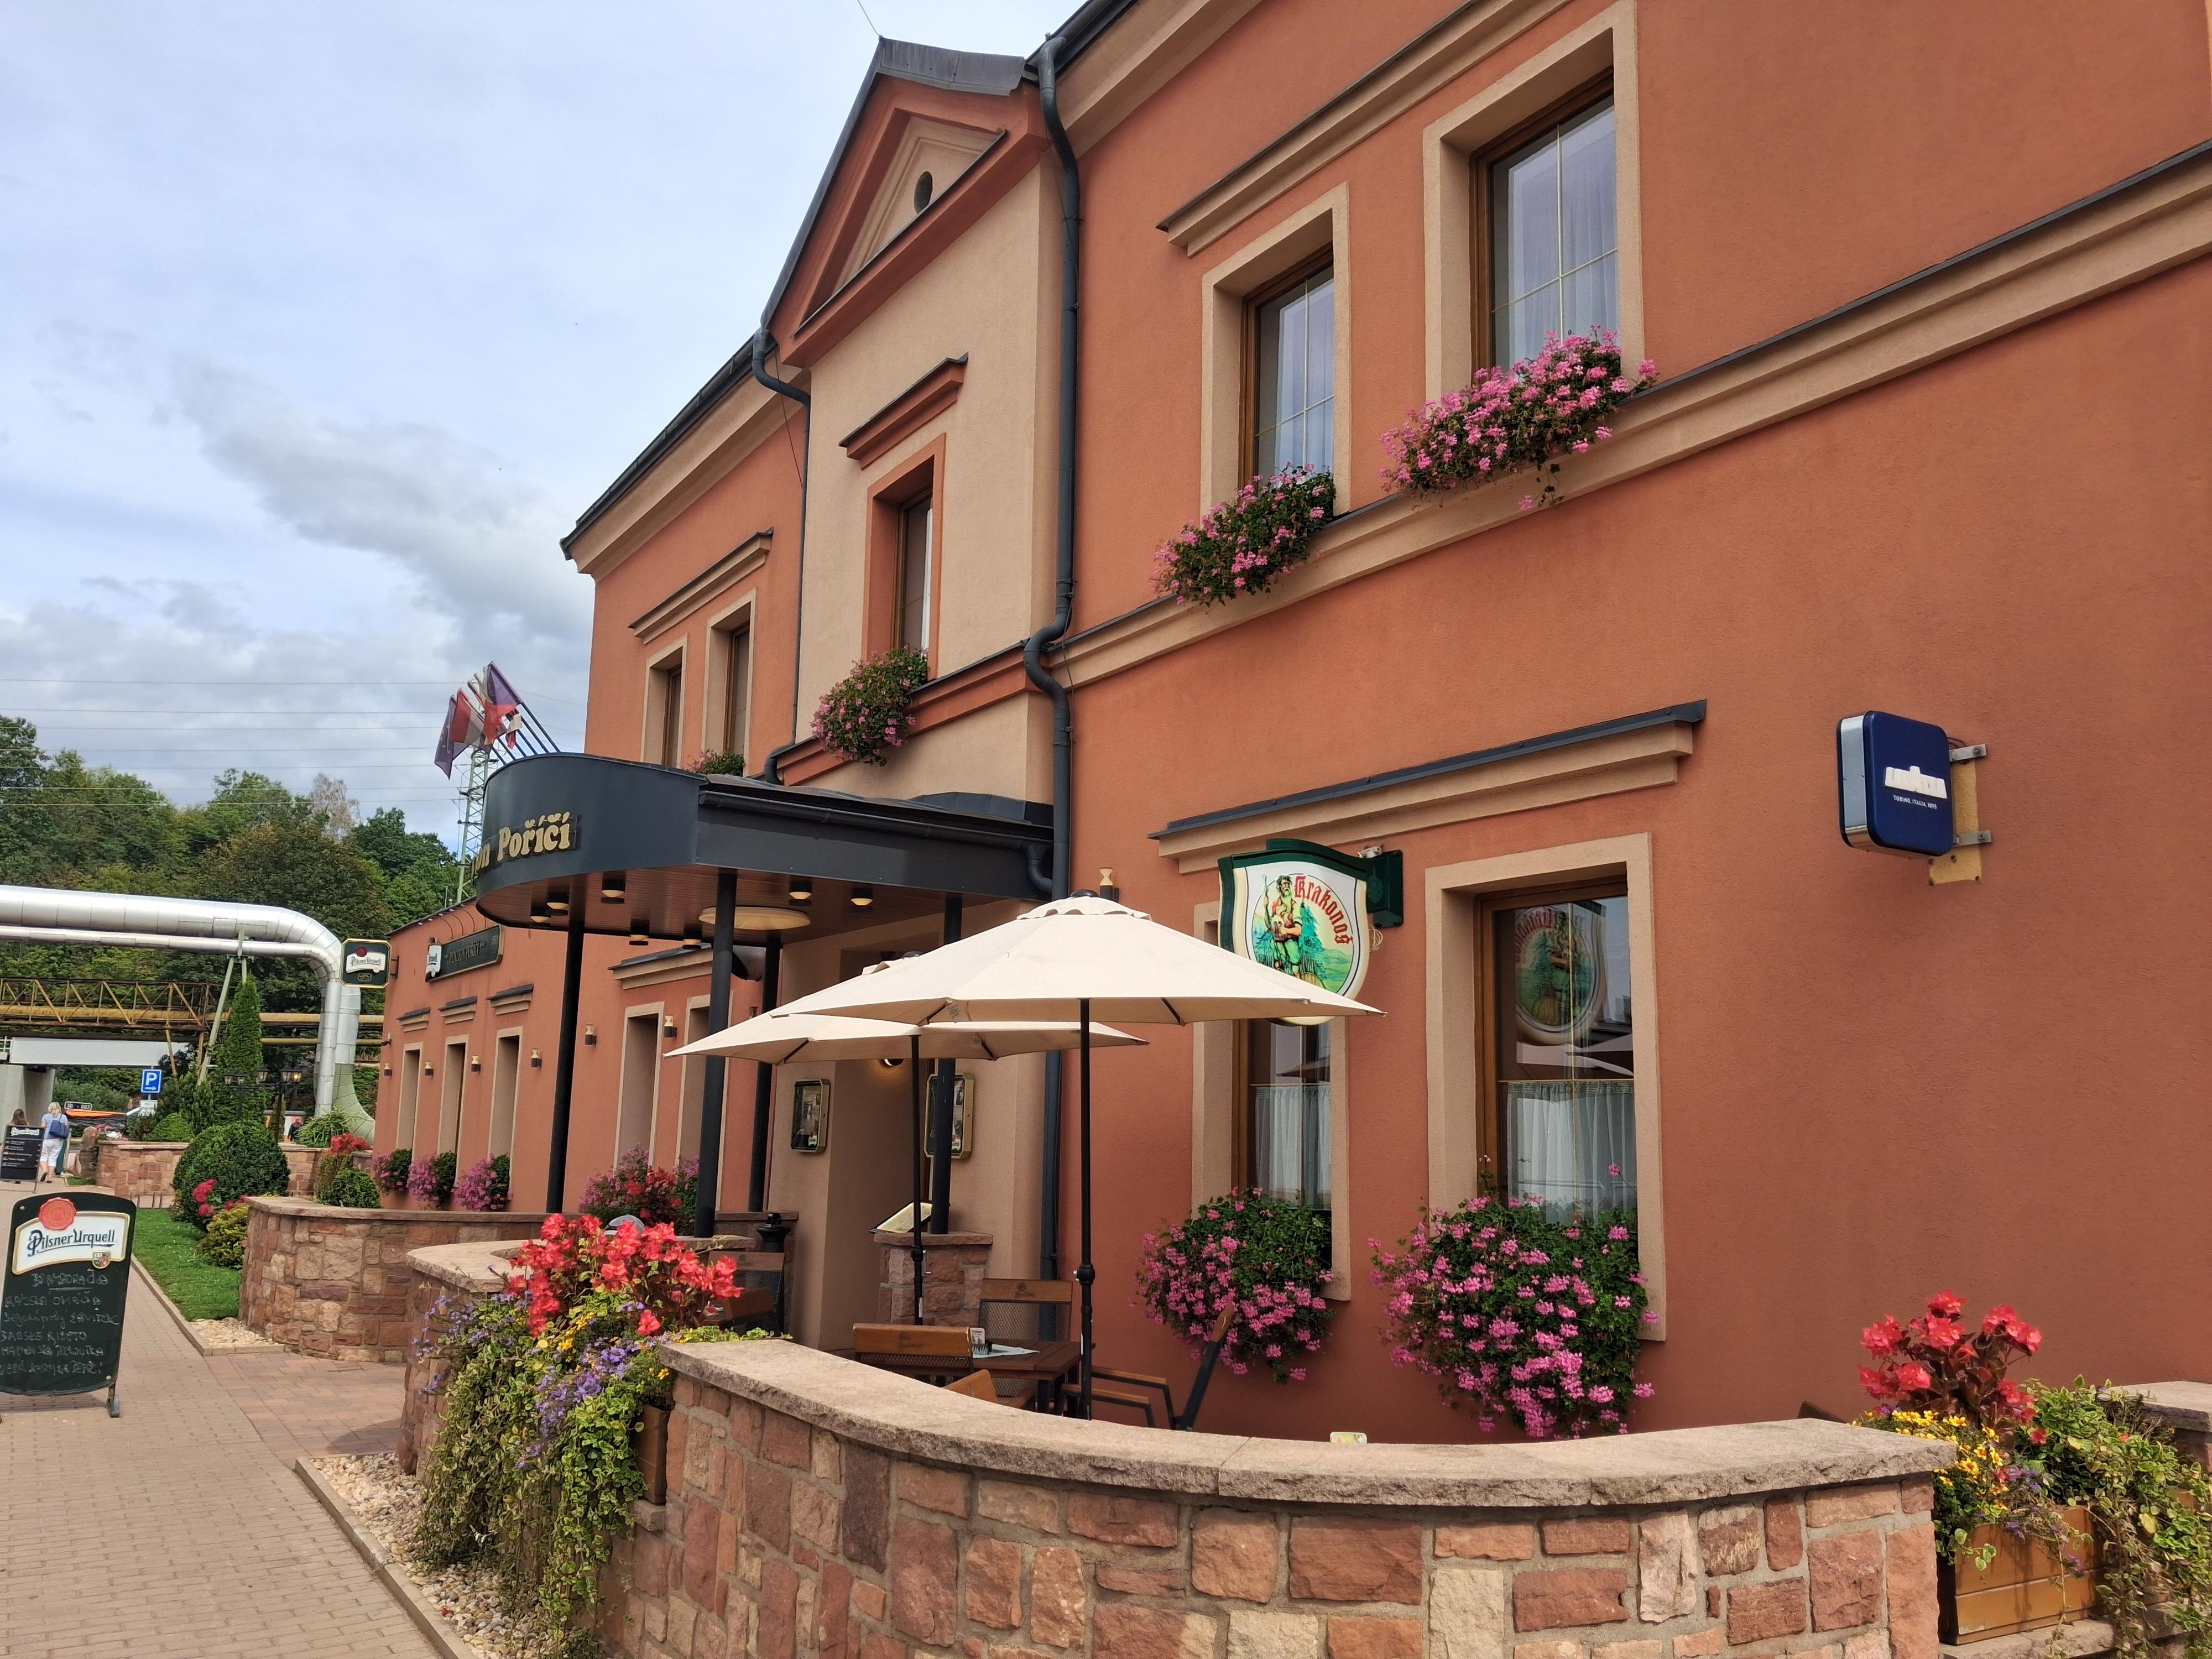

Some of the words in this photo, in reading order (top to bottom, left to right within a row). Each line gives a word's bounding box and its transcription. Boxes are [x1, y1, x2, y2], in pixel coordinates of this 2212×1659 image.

[1912, 799, 1927, 807] ITALIA,
[498, 811, 571, 862] Poříčí
[145, 1072, 157, 1086] P
[27, 1229, 73, 1257] Pilsner
[73, 1228, 115, 1248] Urquell
